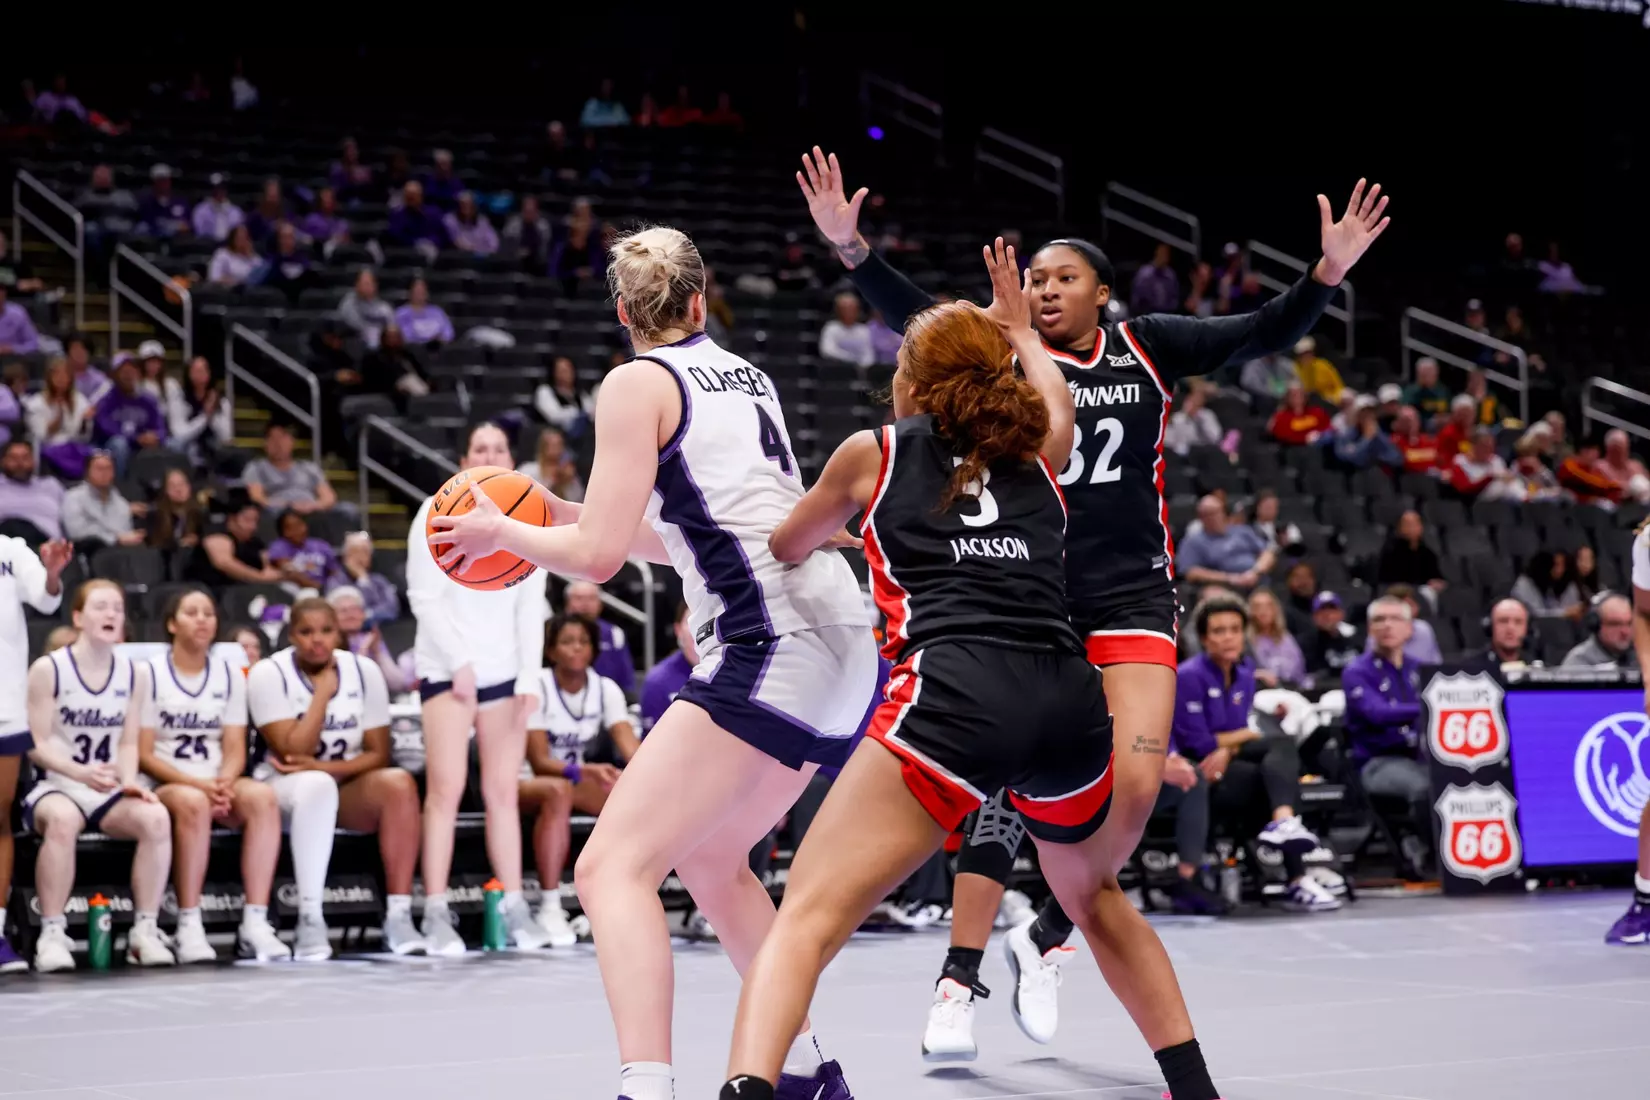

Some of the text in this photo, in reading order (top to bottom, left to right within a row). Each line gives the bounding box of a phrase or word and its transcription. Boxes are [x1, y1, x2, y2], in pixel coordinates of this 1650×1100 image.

[1068, 381, 1141, 408] INNATI
[753, 402, 794, 477] 4
[952, 456, 1000, 528] 3
[949, 536, 1031, 564] JACKSON
[0, 560, 14, 577] N
[1437, 688, 1491, 705] PHILLIPS
[1442, 711, 1491, 751] 66
[72, 733, 111, 765] 34
[1449, 799, 1504, 815] PHILLIPS
[1455, 822, 1504, 862] 66
